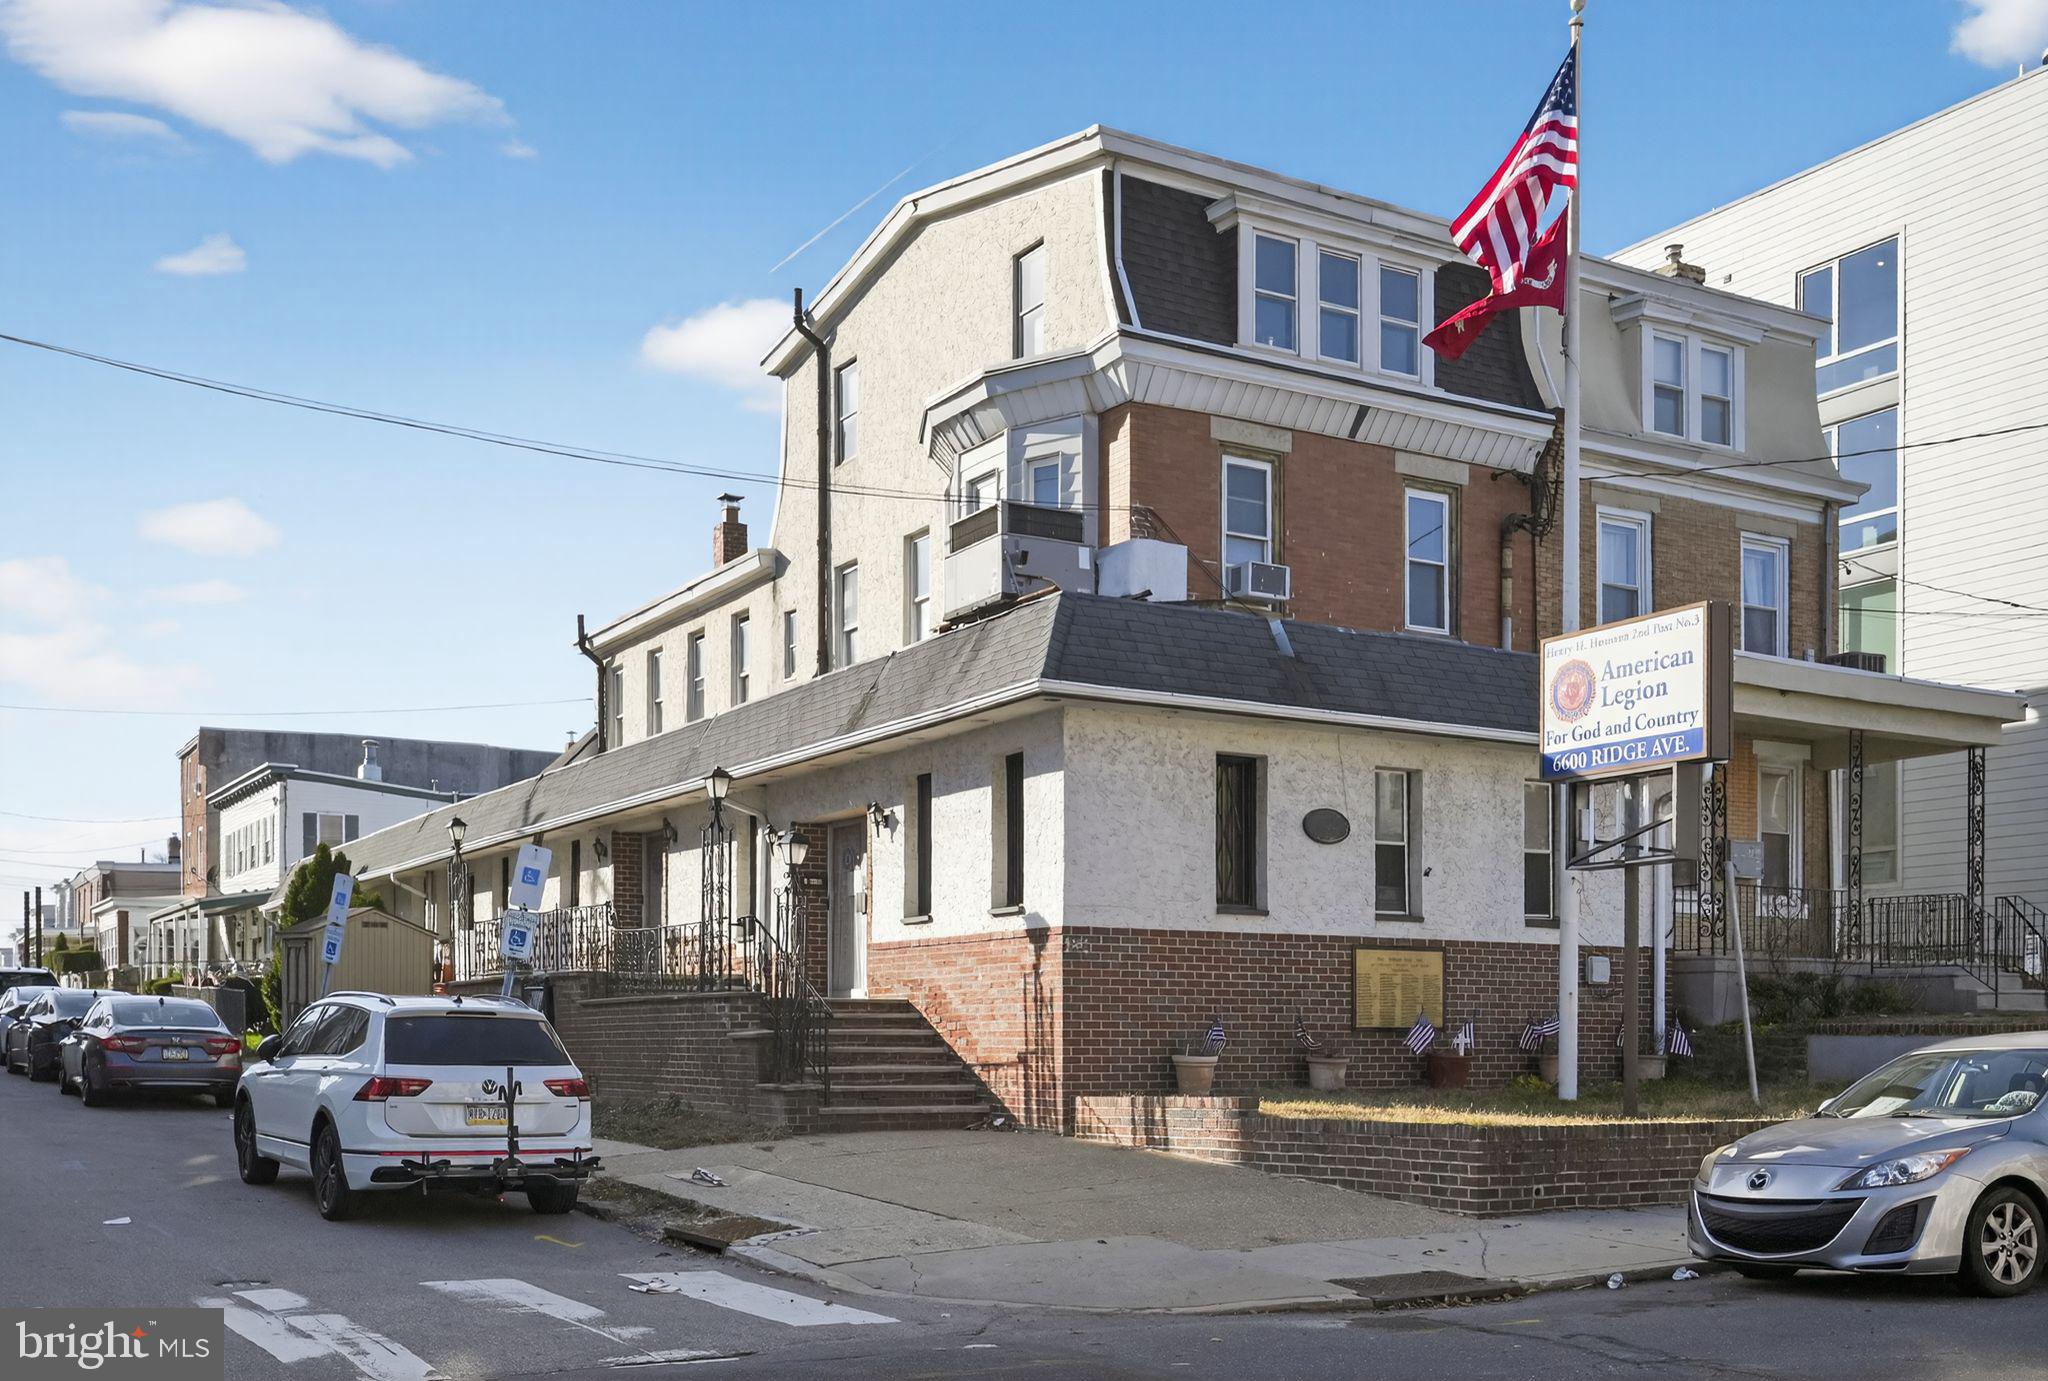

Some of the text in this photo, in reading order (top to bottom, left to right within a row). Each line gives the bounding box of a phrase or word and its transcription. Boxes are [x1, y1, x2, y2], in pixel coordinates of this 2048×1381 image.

[1601, 650, 1694, 681] American
[1601, 680, 1668, 710] Legion
[1546, 709, 1699, 746] For God and Country
[1553, 735, 1690, 772] 6600 RIDGE AVE.
